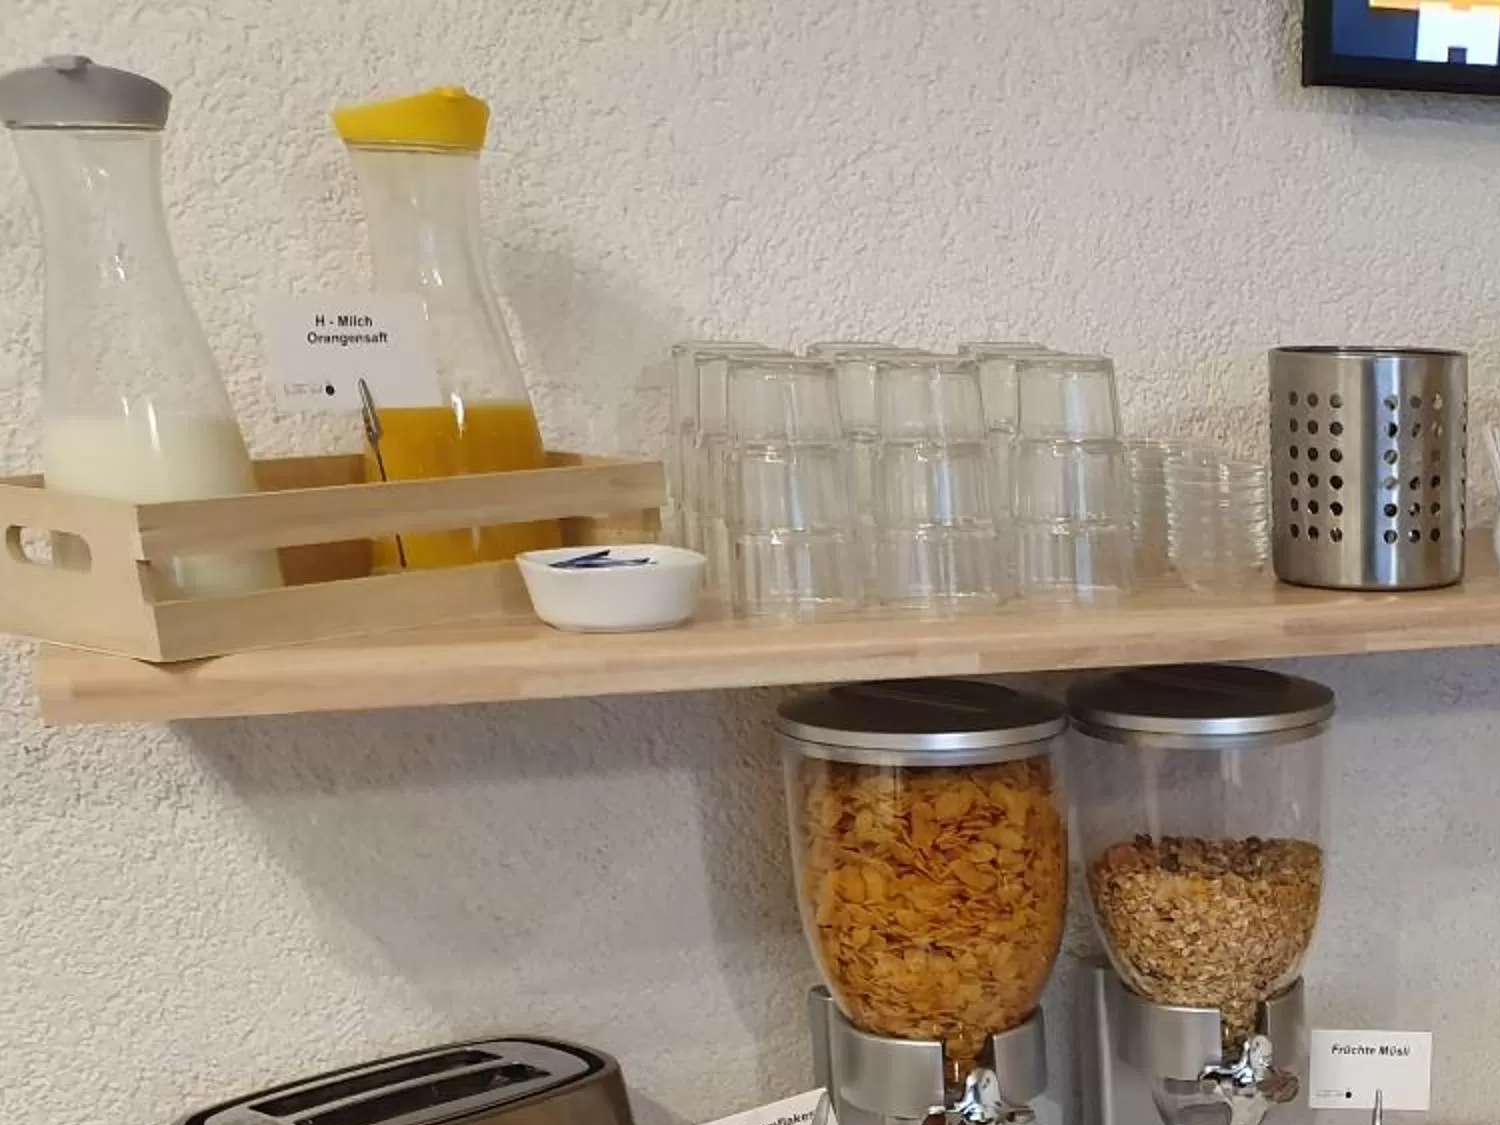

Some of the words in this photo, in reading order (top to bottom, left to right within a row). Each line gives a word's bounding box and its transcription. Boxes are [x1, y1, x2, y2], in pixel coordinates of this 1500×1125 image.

[314, 313, 325, 327] H
[337, 314, 374, 328] Milch
[306, 331, 389, 347] Orangensaft
[1331, 1042, 1377, 1056] Früchte
